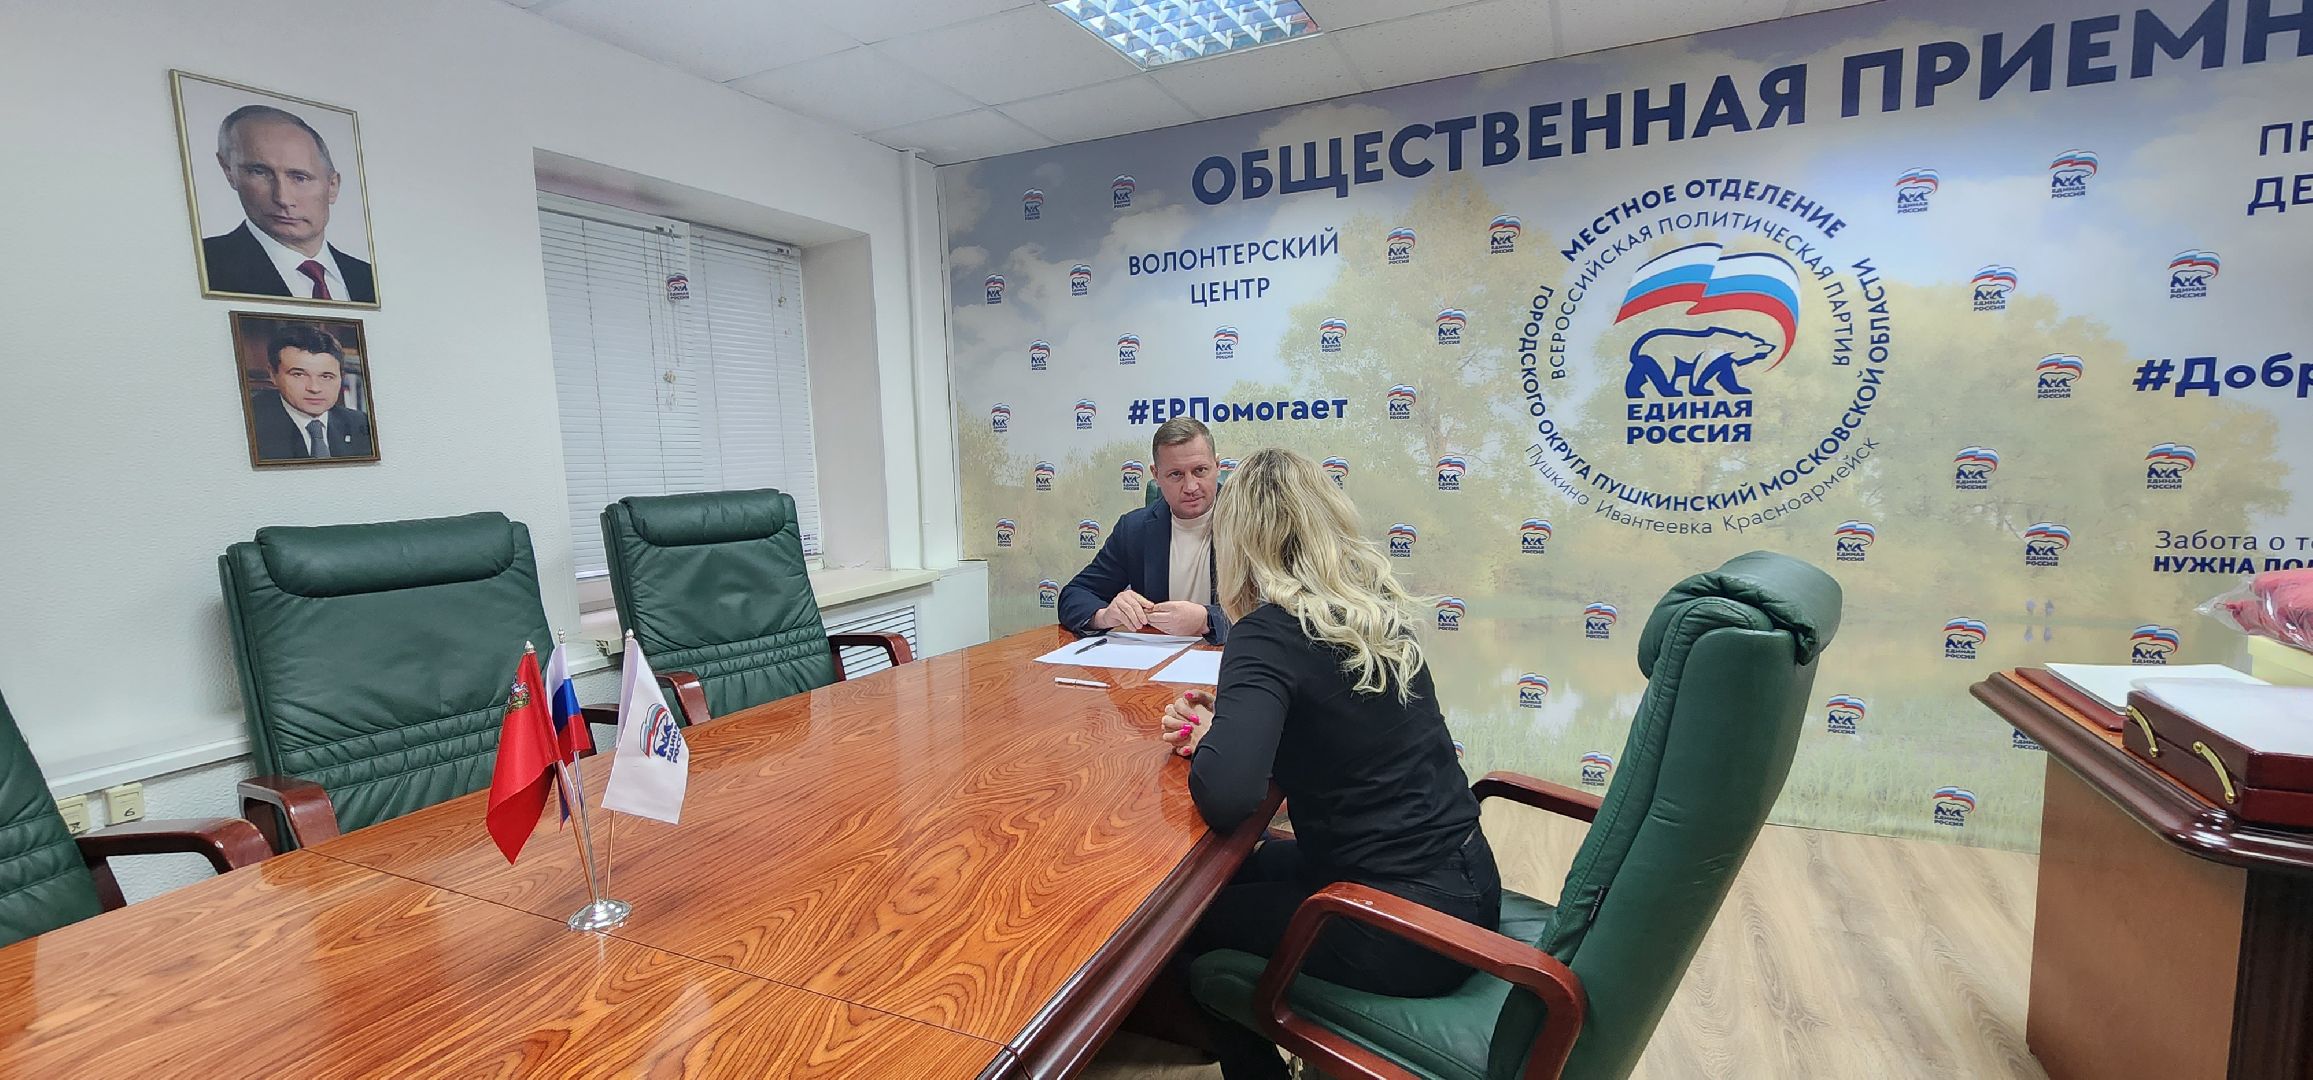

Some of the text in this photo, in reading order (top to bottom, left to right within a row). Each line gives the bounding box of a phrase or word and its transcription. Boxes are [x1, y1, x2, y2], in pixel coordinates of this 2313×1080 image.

[1191, 63, 1808, 205] ОБЩЕСТВЕННАЯ
[2051, 191, 2086, 199] РОССИЯ
[1561, 178, 1846, 263] МЕСТНОЕ ОТДЕЛЕНИЕ
[1128, 227, 1339, 276] ВОЛОНТЕРСКИЙ
[1190, 277, 1271, 307] ЦЕНТР
[1551, 211, 1853, 380] ВСЕРОССИЙСКАЯ ПОЛИТИЧЕСКАЯ ПАРТИЯ
[1519, 258, 1891, 512] ГОРОДСКОГО ОКРУГА ПУШКИНСКИЙ МОСКОВСКОЙ ОБЛАСТИ
[1127, 397, 1348, 425] #ЕРПомогает
[1627, 400, 1753, 422] ЕДИНАЯ
[1626, 422, 1752, 445] РОССИЯ
[1525, 437, 1880, 535] Пушкино Ивантеевка Красноармейск
[2155, 529, 2257, 550] Забота
[2269, 536, 2285, 551] о
[2153, 555, 2255, 574] НУЖНА
